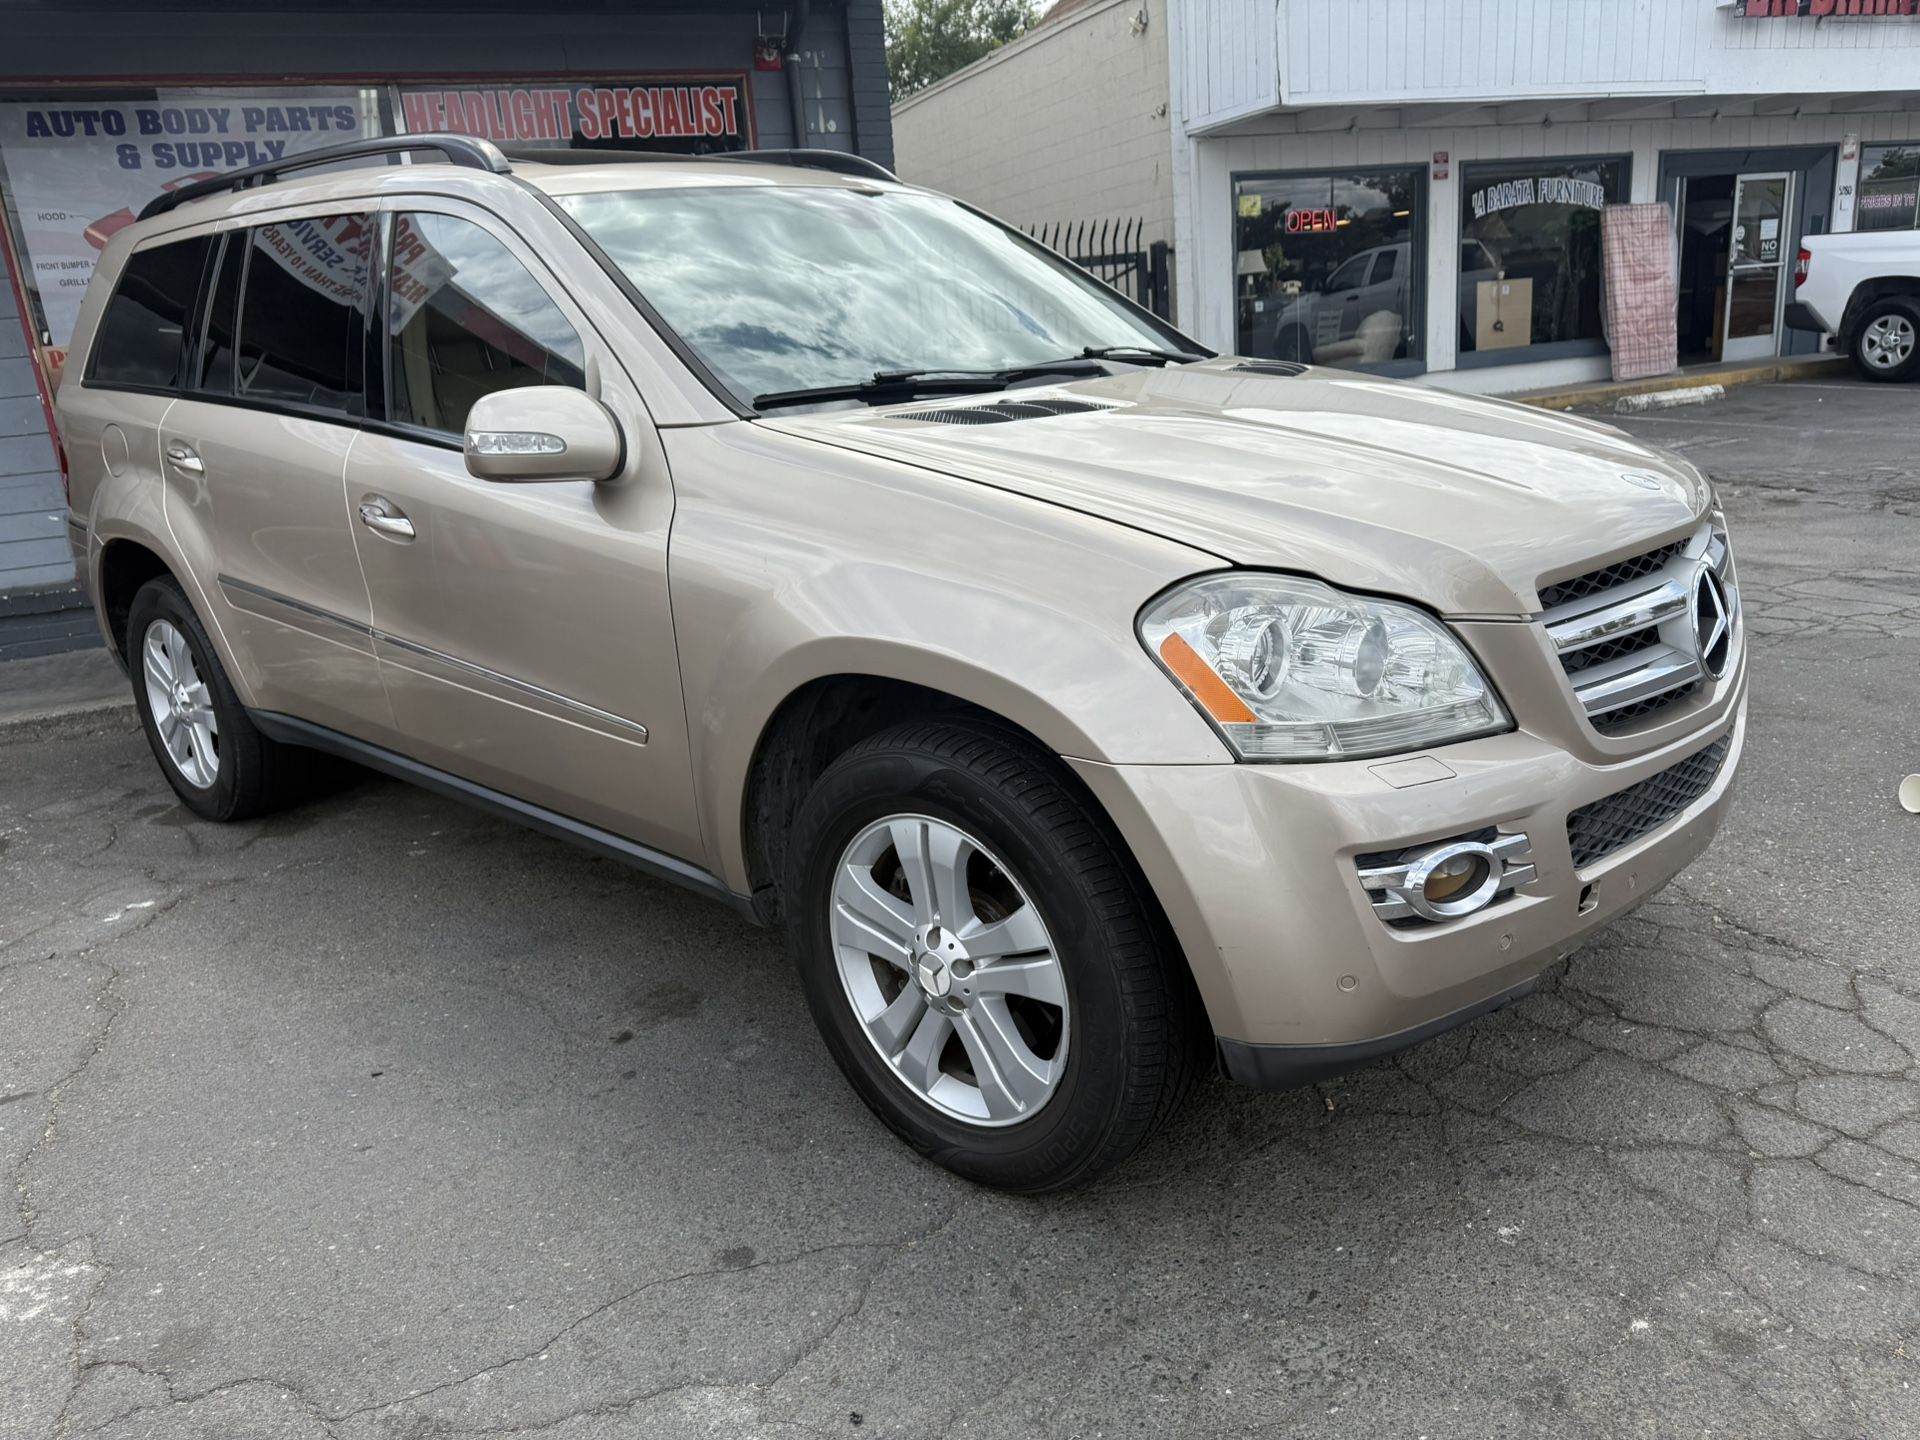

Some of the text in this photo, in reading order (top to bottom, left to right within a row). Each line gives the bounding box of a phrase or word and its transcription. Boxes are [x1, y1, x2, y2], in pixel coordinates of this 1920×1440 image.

[26, 105, 357, 137] AUTO BODY PARTS
[401, 86, 737, 140] HEADLIGHT SPECIALIST
[116, 140, 286, 169] & SUPPLY
[1487, 178, 1535, 213] BARATA
[1537, 176, 1605, 211] FURNITURE
[37, 212, 66, 222] HOOD
[1287, 209, 1337, 232] OPEN
[1761, 240, 1777, 251] NO
[36, 260, 90, 271] FRONT BUMPER
